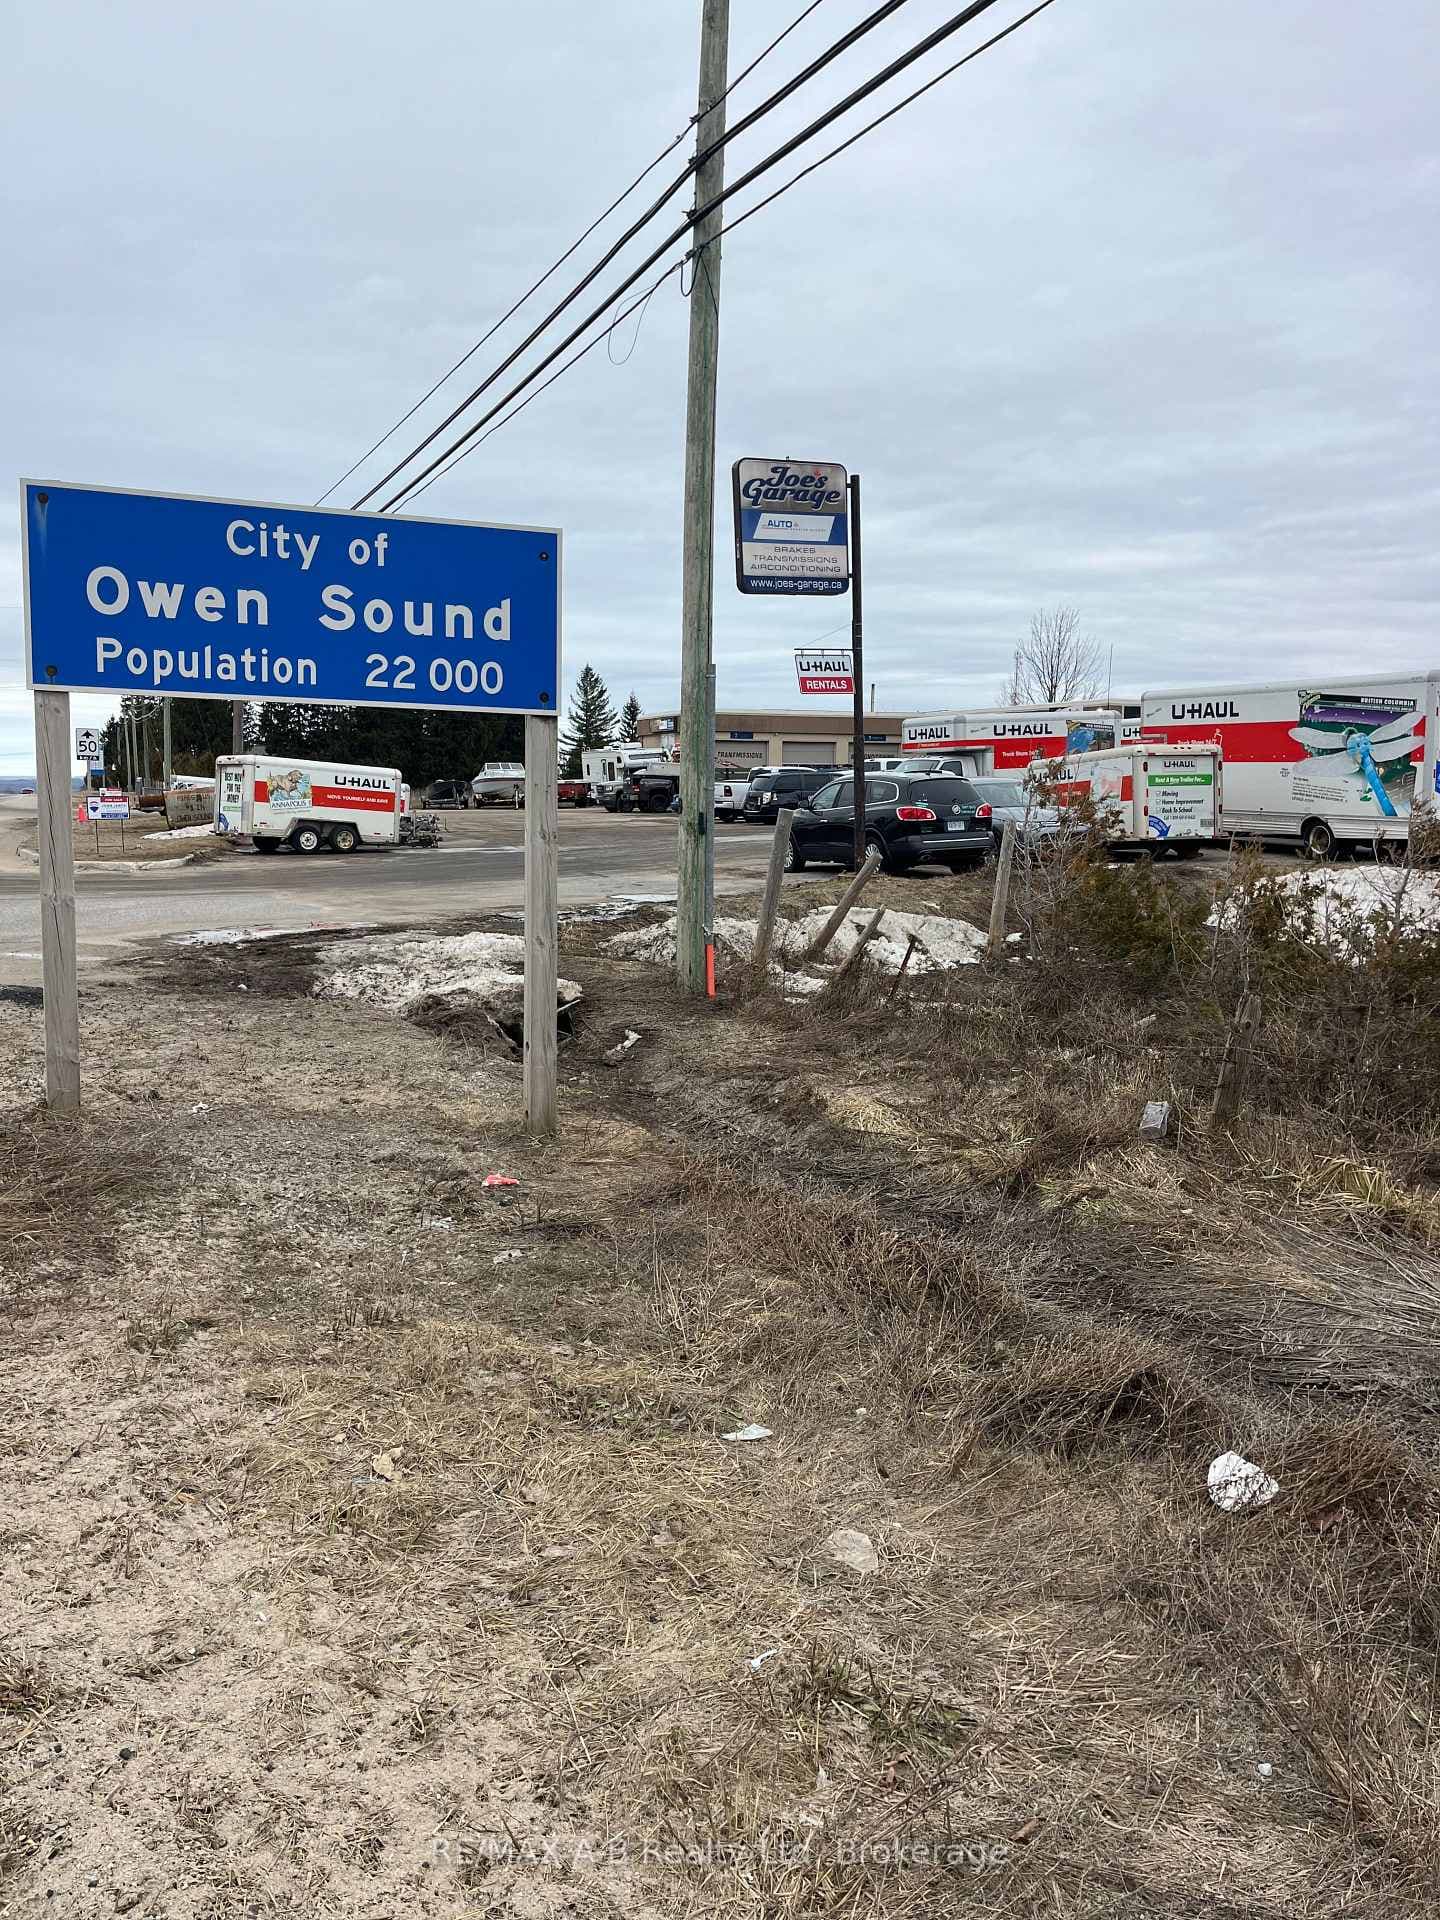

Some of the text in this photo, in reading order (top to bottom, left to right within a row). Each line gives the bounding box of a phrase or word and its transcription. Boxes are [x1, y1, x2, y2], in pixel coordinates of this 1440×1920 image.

[742, 477, 841, 509] Garage
[767, 519, 793, 529] AUTO
[226, 519, 389, 570] City of
[774, 546, 816, 554] BRAKES
[752, 554, 838, 564] TRANSMISSIONS
[750, 578, 842, 590] www.joes-garage.ca
[86, 566, 512, 641] Owen Sound
[95, 637, 318, 686] Population
[799, 661, 849, 672] U-HAUL
[806, 679, 848, 690] RENTALS
[1360, 697, 1414, 706] BRITISH COLUMBIA
[1171, 702, 1240, 720] U-HAUL
[908, 726, 951, 740] U-HAUL
[993, 723, 1053, 737] U-HAUL
[79, 741, 98, 753] 50
[335, 775, 391, 790] U-HAUL
[271, 800, 307, 809] ANNAPOLIS
